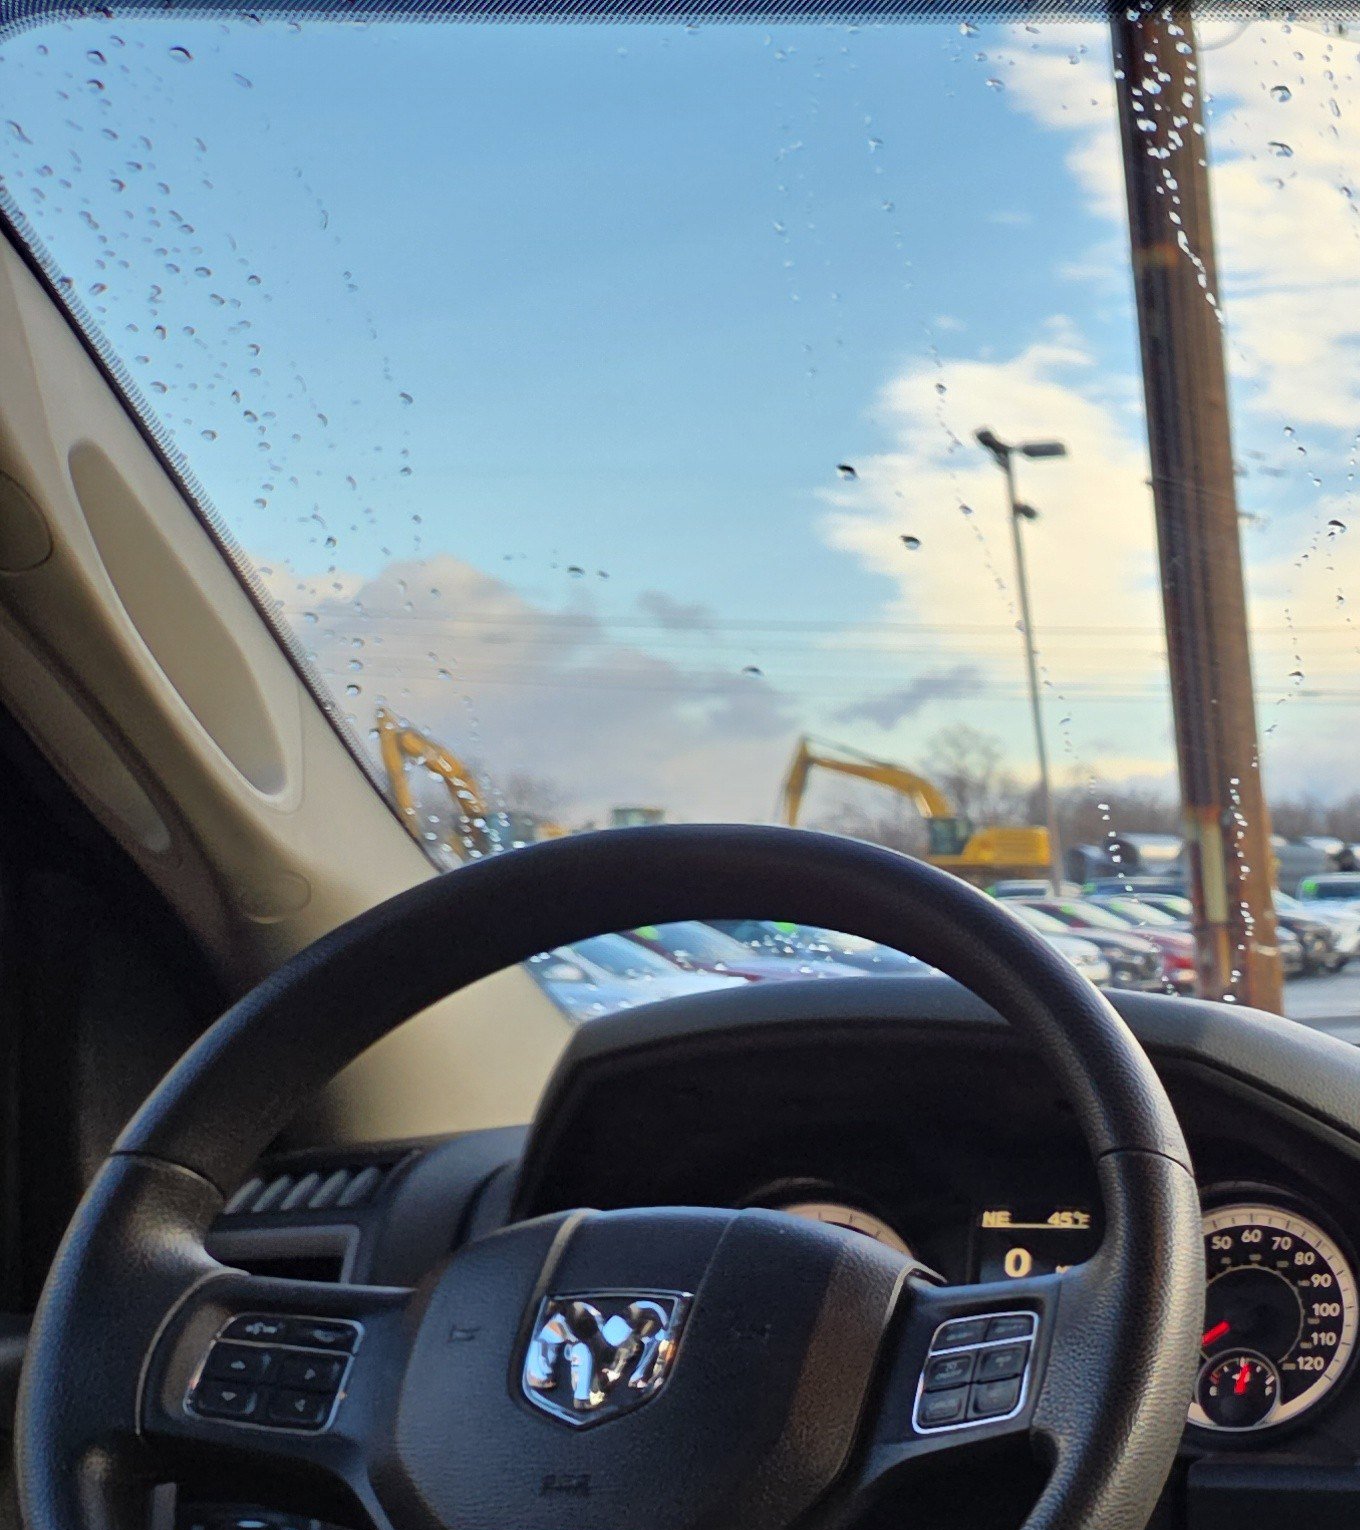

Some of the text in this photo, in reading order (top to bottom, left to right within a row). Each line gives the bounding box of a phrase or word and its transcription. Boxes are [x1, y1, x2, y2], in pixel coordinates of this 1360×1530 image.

[1211, 1236, 1232, 1250] 50
[1241, 1229, 1262, 1243] 60
[1271, 1236, 1292, 1250] 70
[1294, 1251, 1315, 1266] 80
[1310, 1273, 1332, 1288] 90
[1312, 1302, 1341, 1317] 100
[1311, 1332, 1337, 1347] 110
[1297, 1356, 1325, 1371] 120
